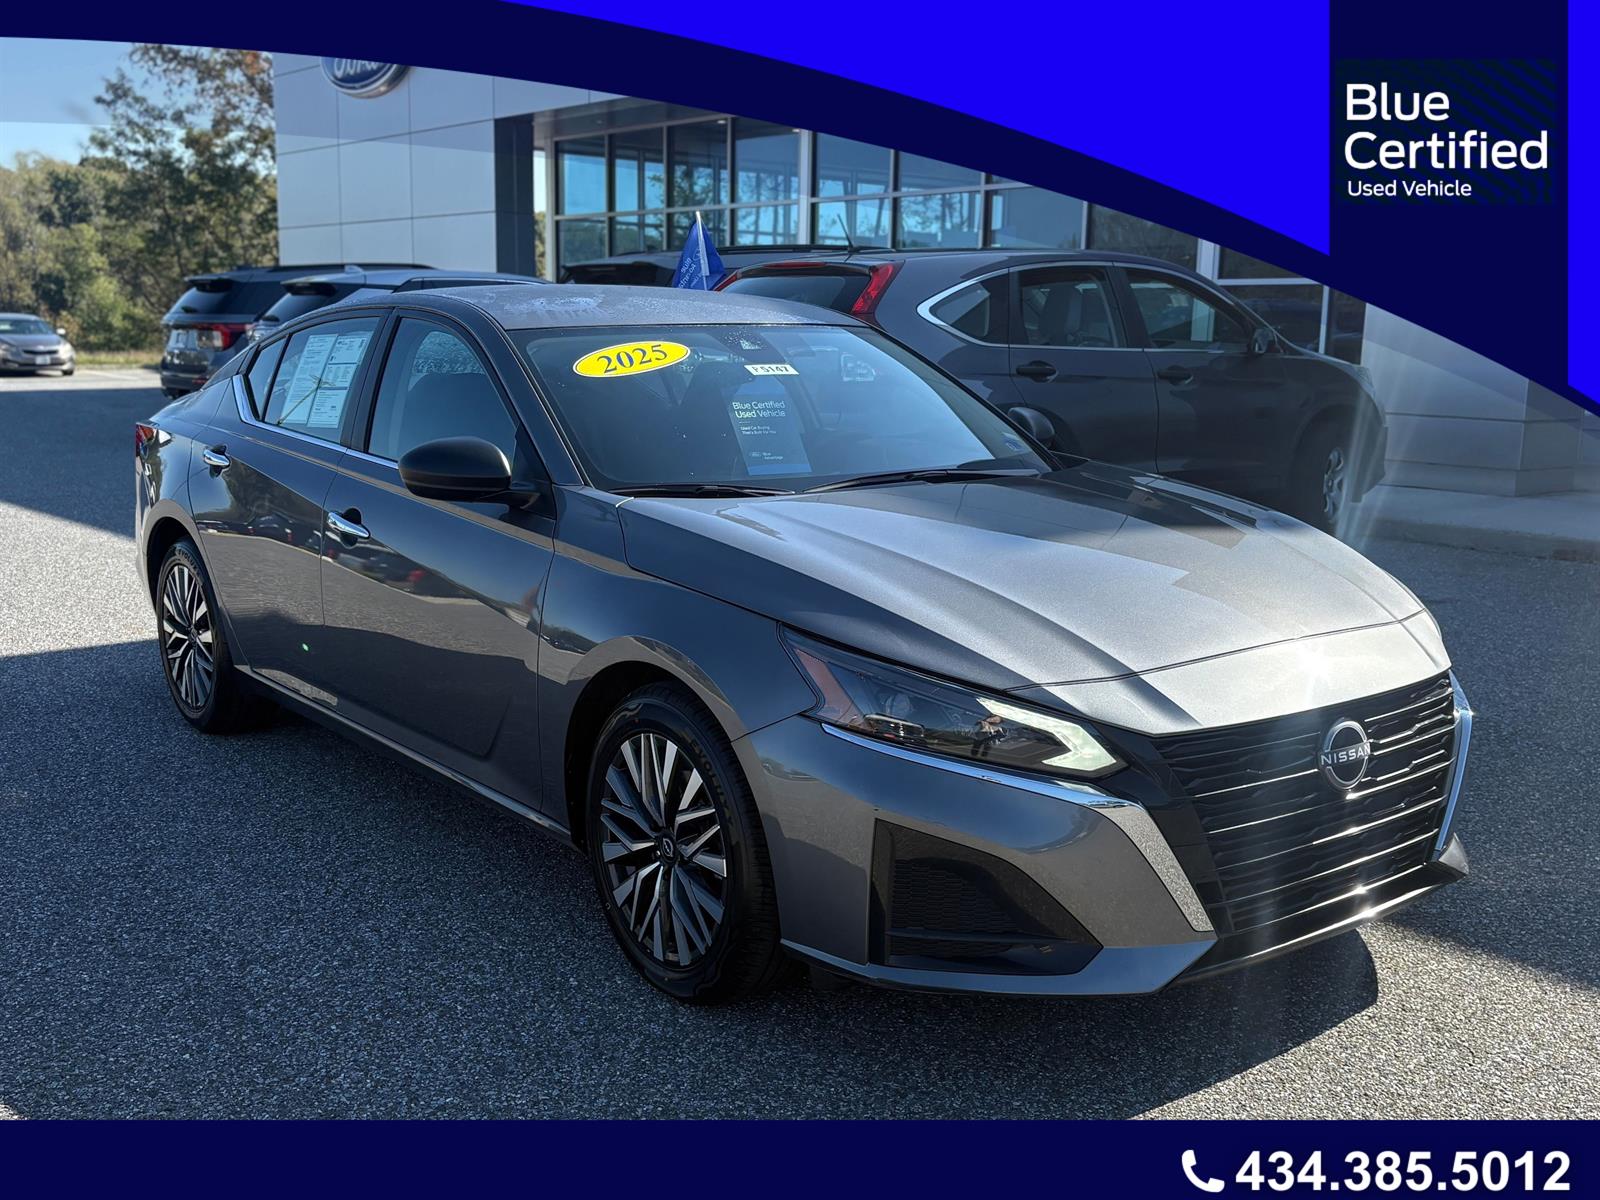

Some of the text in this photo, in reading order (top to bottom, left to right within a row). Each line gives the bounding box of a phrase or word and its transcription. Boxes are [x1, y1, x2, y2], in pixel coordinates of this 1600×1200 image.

[597, 344, 668, 374] 2025
[732, 400, 786, 410] Blue Certified
[735, 410, 786, 418] Used Vehicle
[1320, 741, 1371, 766] NISSAN
